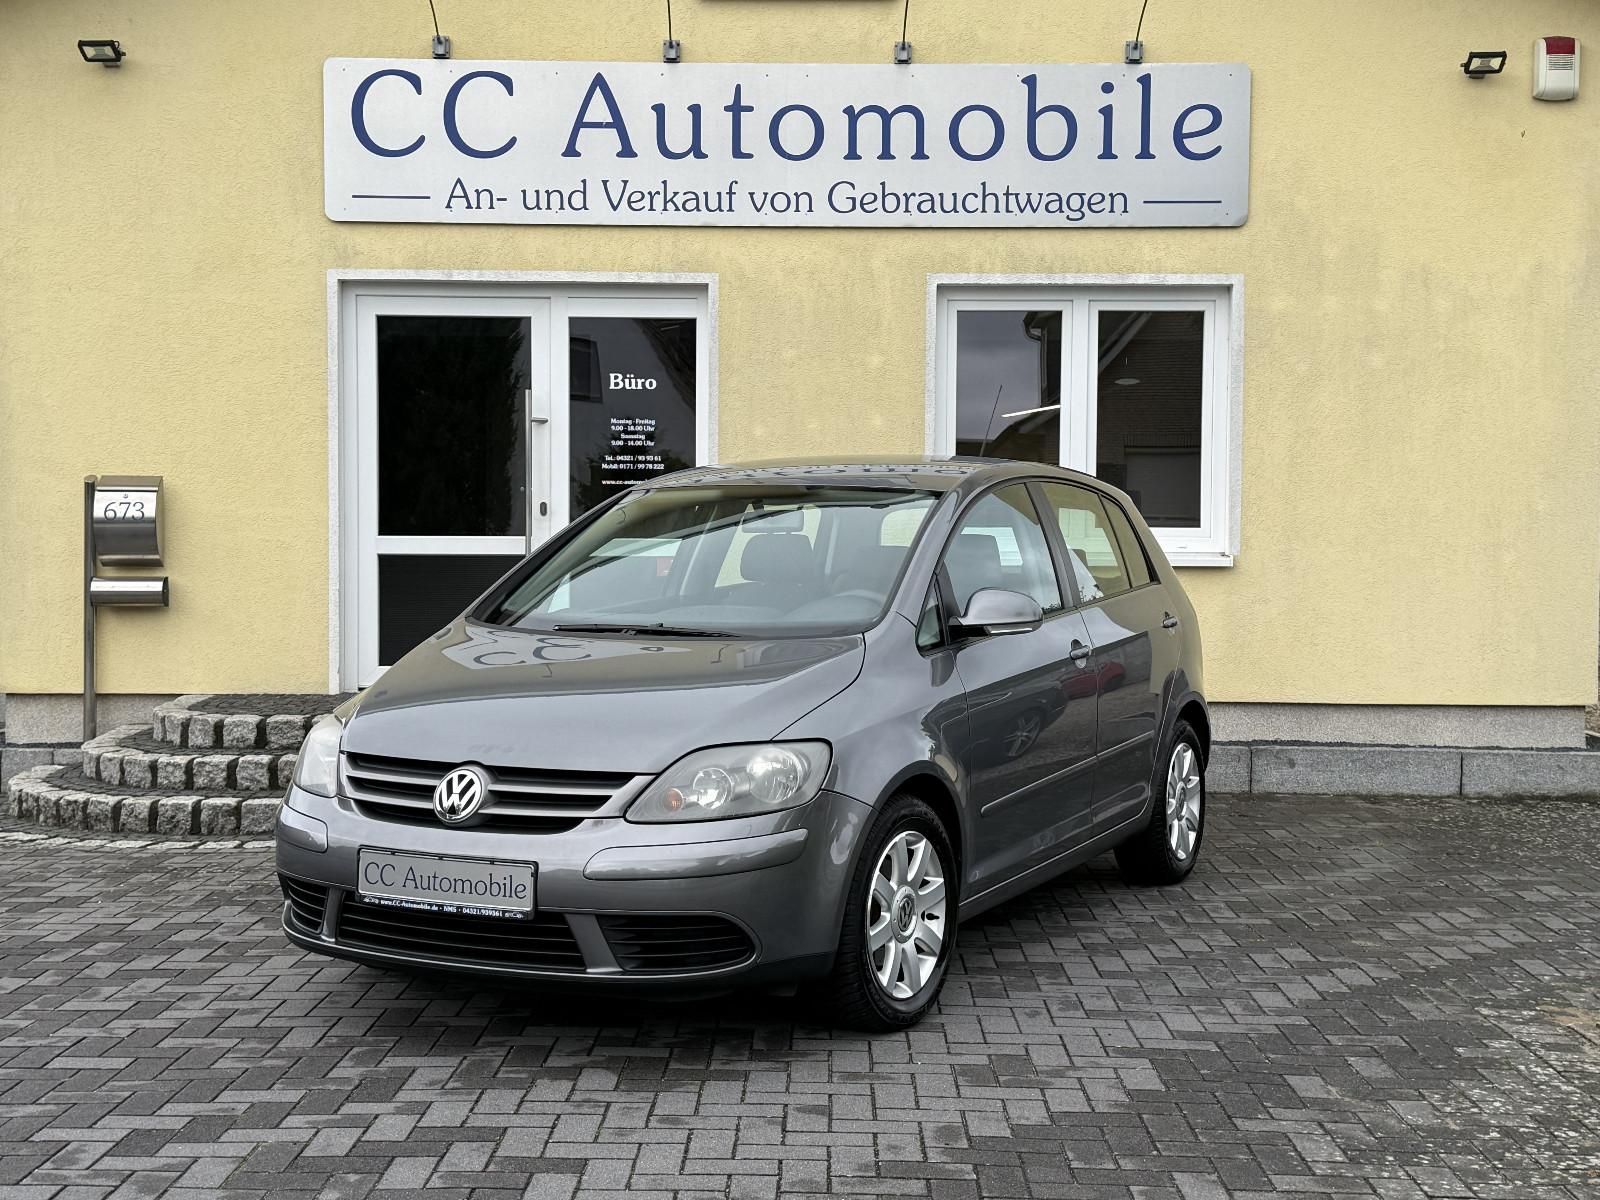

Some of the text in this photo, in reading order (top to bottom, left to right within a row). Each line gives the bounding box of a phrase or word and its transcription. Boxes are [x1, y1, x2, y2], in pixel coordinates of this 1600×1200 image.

[350, 68, 1224, 162] CC Automobile
[444, 176, 1130, 222] An- und Verkauf von Gebrauchtwagen
[608, 372, 658, 391] Büro
[610, 418, 633, 426] Montag
[635, 418, 656, 426] Freitag
[620, 432, 646, 441] Samstag
[103, 501, 145, 521] 673
[363, 861, 527, 900] CC Automobile
